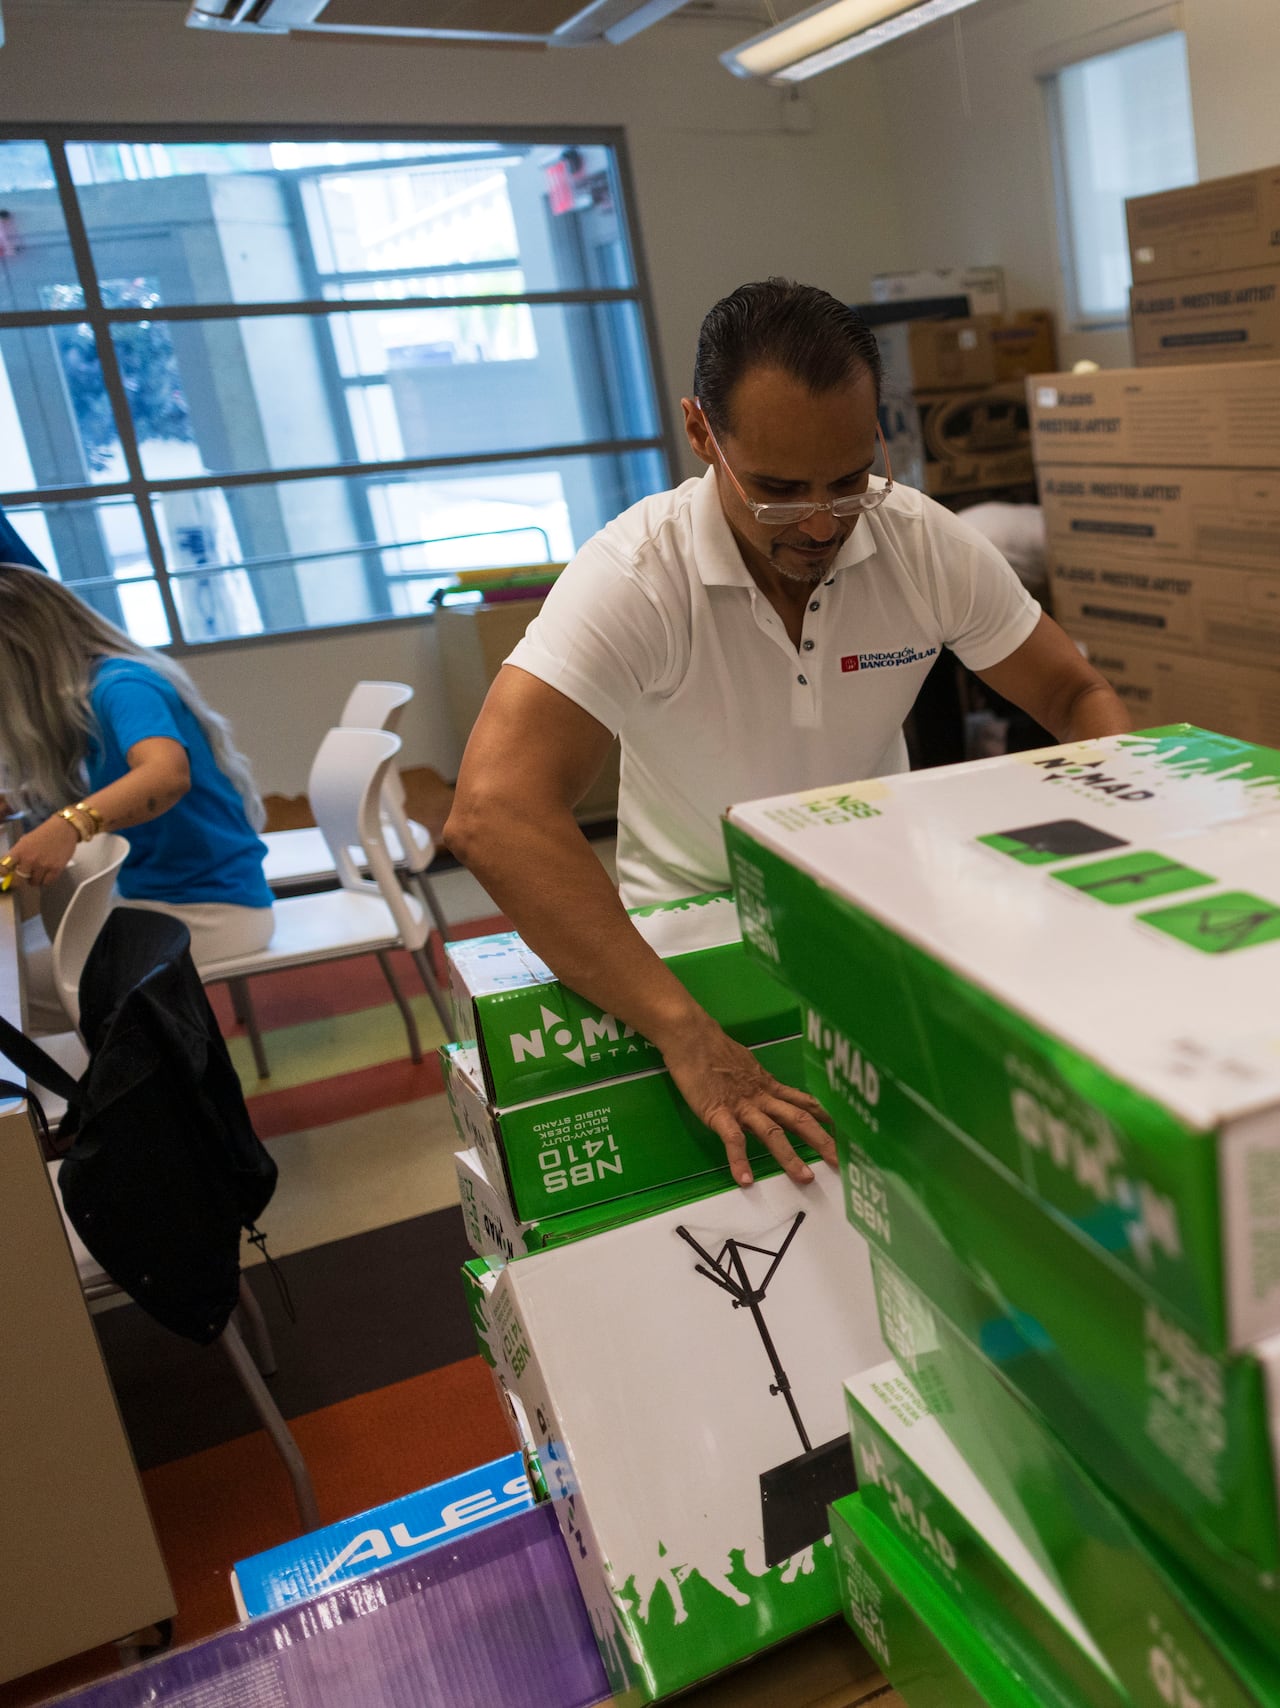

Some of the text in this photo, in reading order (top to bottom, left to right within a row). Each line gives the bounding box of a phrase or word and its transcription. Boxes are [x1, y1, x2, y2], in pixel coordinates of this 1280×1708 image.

[859, 647, 915, 662] FUNDACIÓN
[860, 648, 937, 670] BANCO POPULAR
[509, 1004, 640, 1068] NOM
[590, 1040, 657, 1062] STAN
[807, 1008, 881, 1106] NOMAD
[532, 1107, 611, 1132] MUSIC STAND
[539, 1116, 609, 1139] SOLID DESK
[541, 1125, 610, 1148] HEAVY-DUTY
[538, 1134, 619, 1171] 1410
[543, 1154, 624, 1194] NBS
[850, 1189, 892, 1246] NBS
[510, 1343, 532, 1381] NBS
[309, 1474, 534, 1588] ALES
[850, 1599, 891, 1667] NBS
